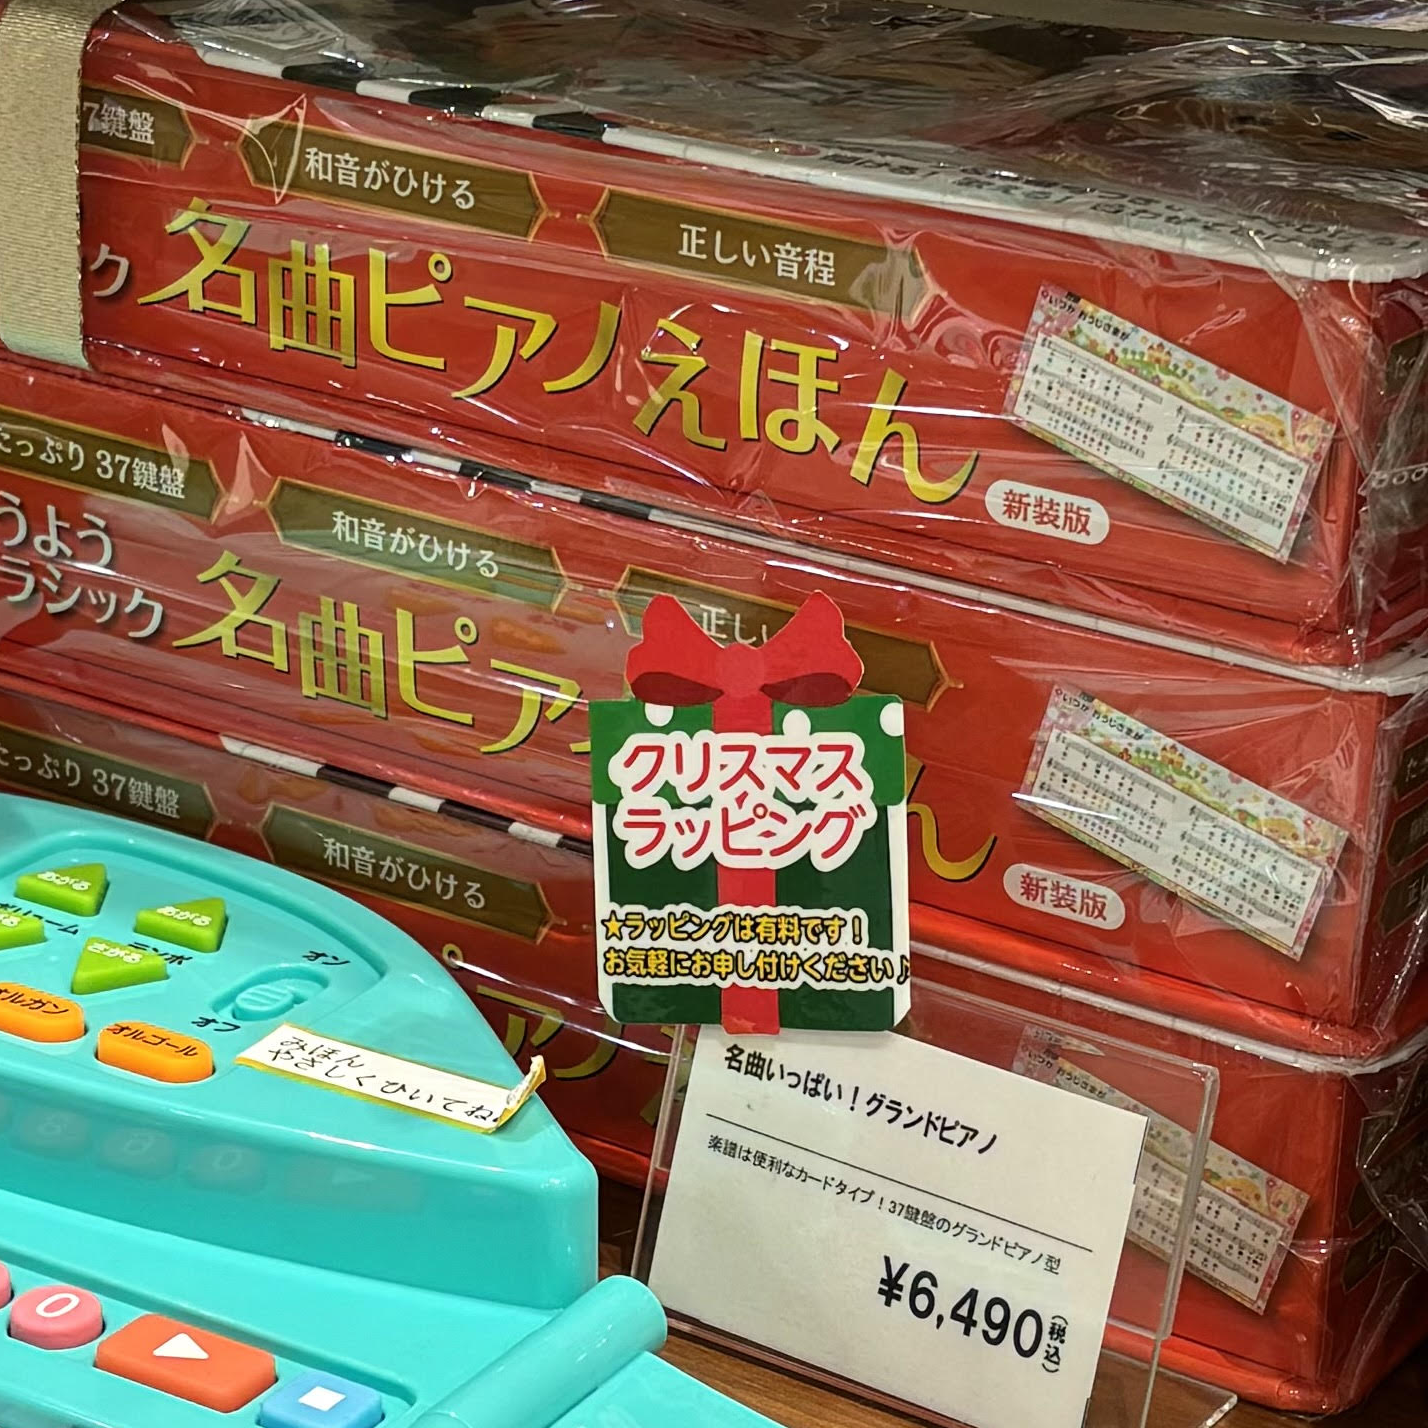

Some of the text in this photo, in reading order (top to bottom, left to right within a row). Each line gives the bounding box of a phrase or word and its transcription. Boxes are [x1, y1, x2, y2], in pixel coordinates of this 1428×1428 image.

[304, 146, 478, 212] 和音がひける
[677, 222, 837, 288] 正しい音程
[137, 195, 980, 506] 名曲ピアノえほん
[95, 452, 187, 500] 37鍵盤
[1002, 487, 1093, 537] 新装版
[331, 508, 500, 580] 和音がひける
[623, 741, 863, 792] クリスマス
[623, 803, 867, 860] ラッピング
[323, 835, 487, 910] 和音がひける
[1019, 871, 1109, 922] 新装版
[301, 948, 351, 967] オン
[107, 1022, 200, 1059] オルゴール
[191, 1015, 241, 1034] オフ
[279, 1035, 365, 1069] みほん
[724, 1043, 1000, 1156] 名曲いっぱい！グランドピアノ
[35, 1292, 80, 1318] 0
[878, 1254, 1044, 1361] ¥6,490
